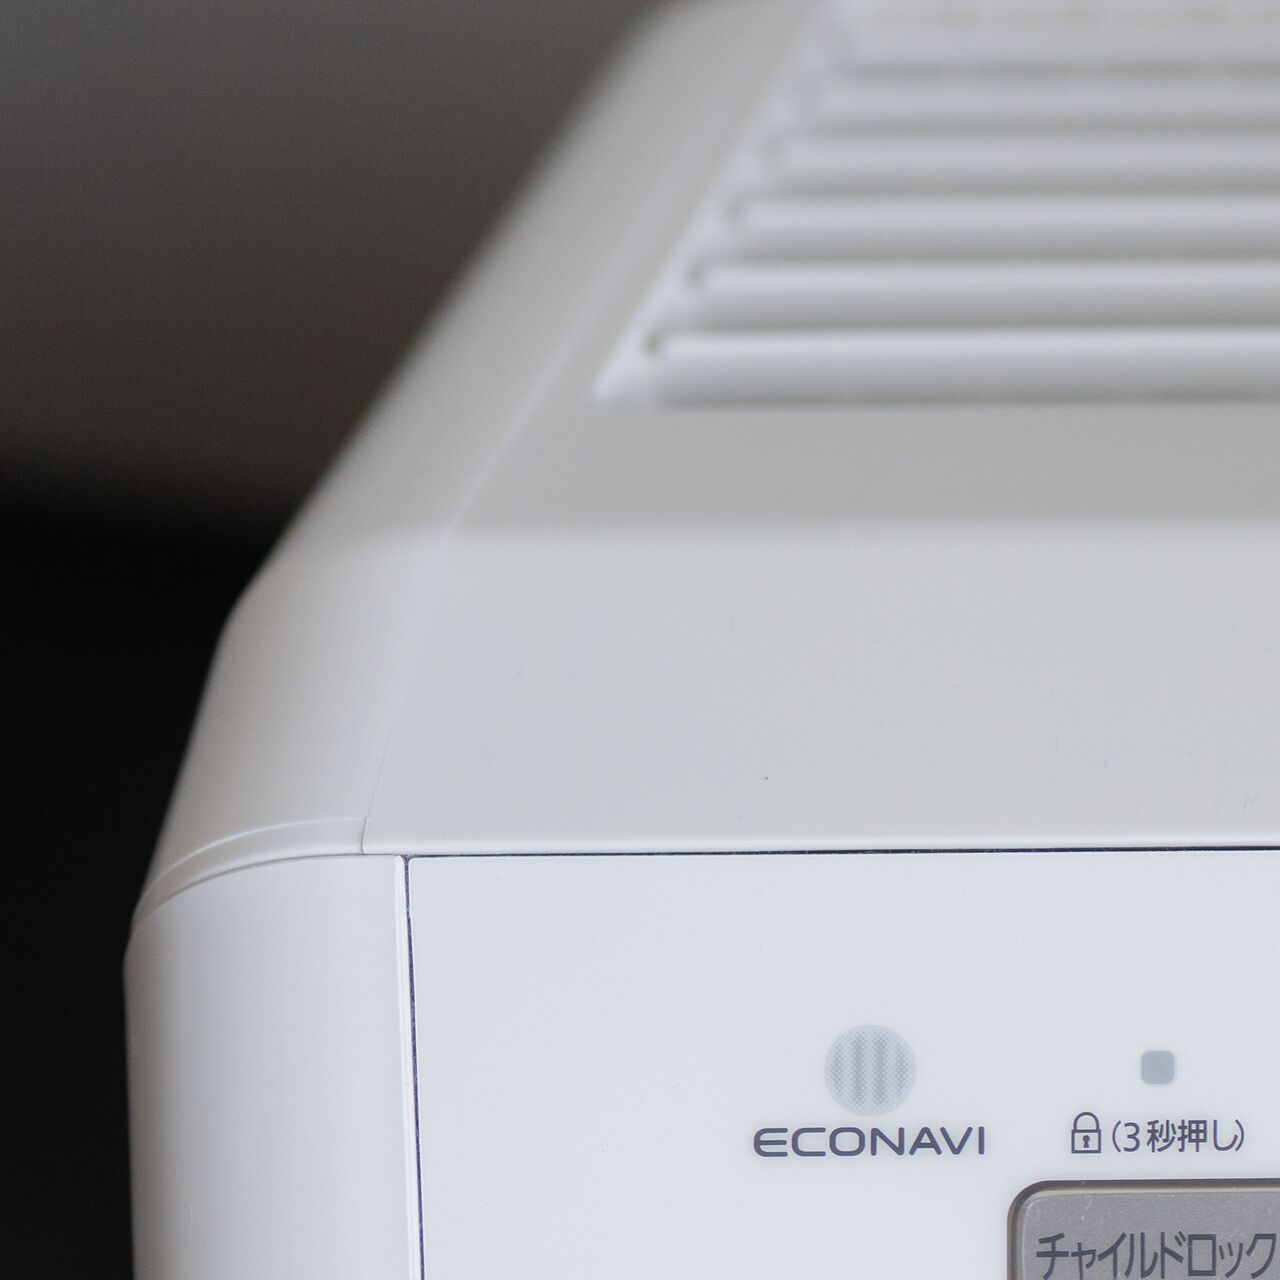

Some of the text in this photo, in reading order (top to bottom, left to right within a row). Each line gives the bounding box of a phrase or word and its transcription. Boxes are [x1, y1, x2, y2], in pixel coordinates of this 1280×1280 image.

[753, 1126, 985, 1158] ECONAVI
[1035, 1230, 1277, 1280] チャイルドロック
